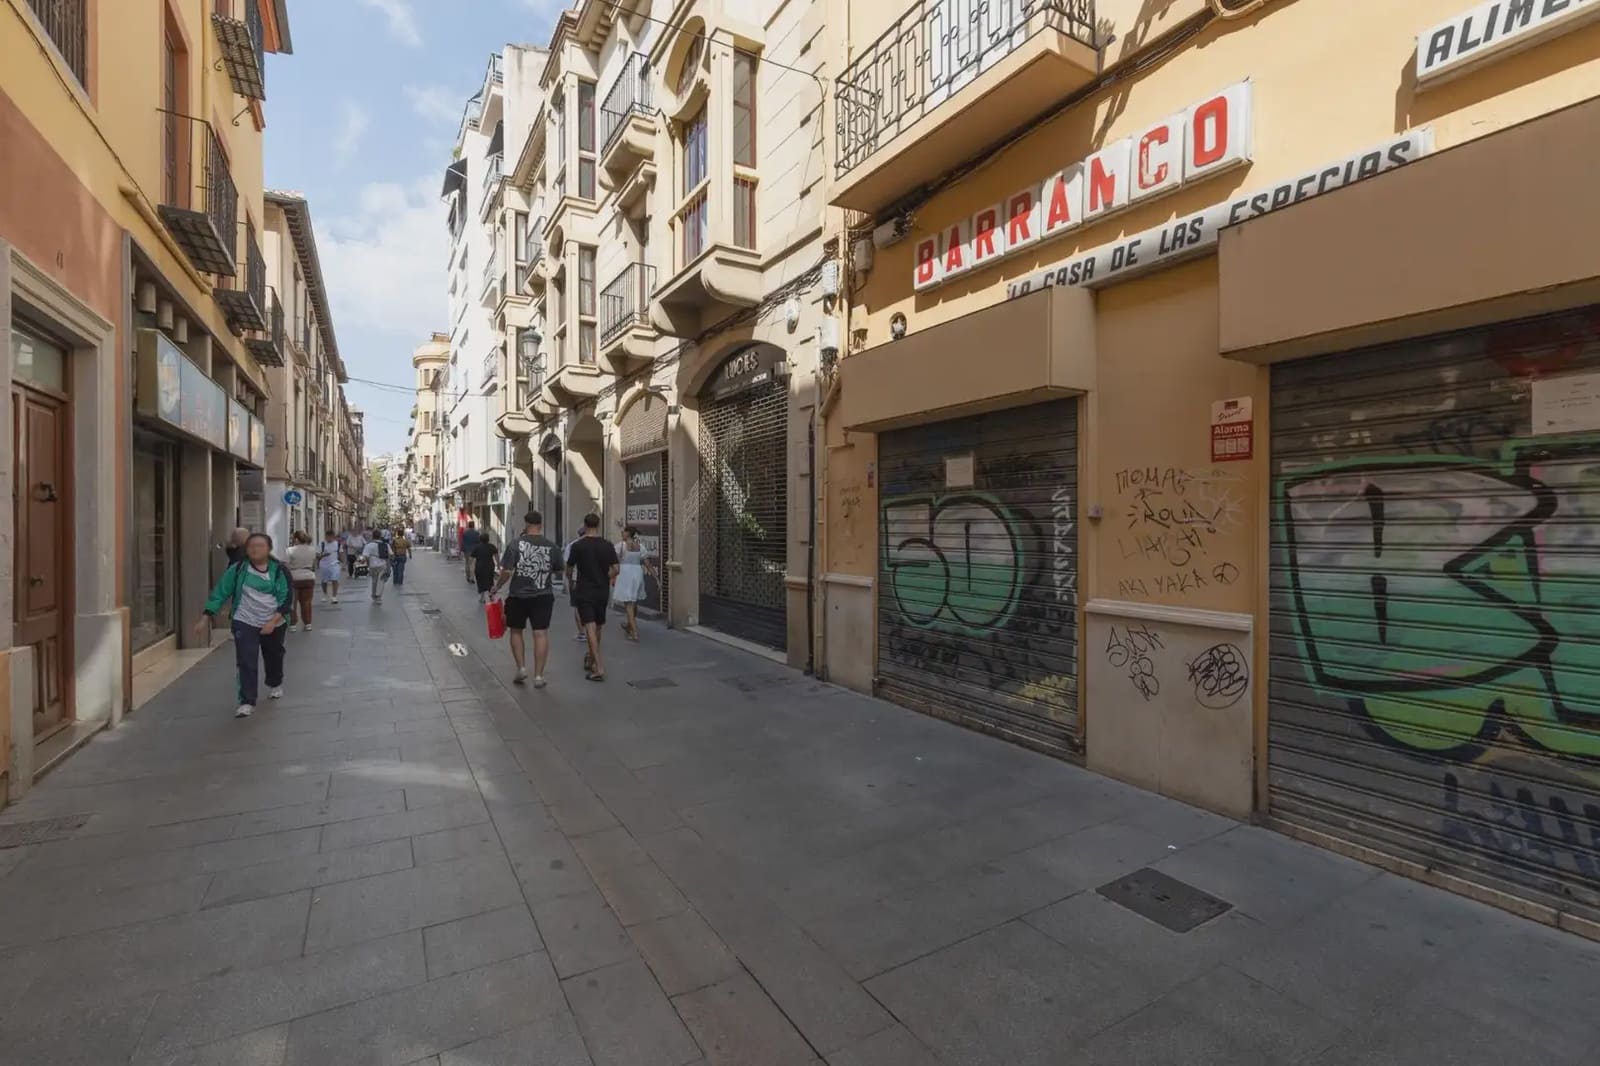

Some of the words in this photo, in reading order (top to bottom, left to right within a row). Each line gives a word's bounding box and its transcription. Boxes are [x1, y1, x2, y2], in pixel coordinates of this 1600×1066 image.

[917, 96, 1228, 284] BARRANCO
[1043, 256, 1097, 288] CASA
[1110, 239, 1142, 273] DE
[1158, 216, 1205, 256] LAS
[1213, 423, 1250, 434] Alarma
[628, 471, 658, 490] HOMIX
[636, 508, 658, 521] VENDE
